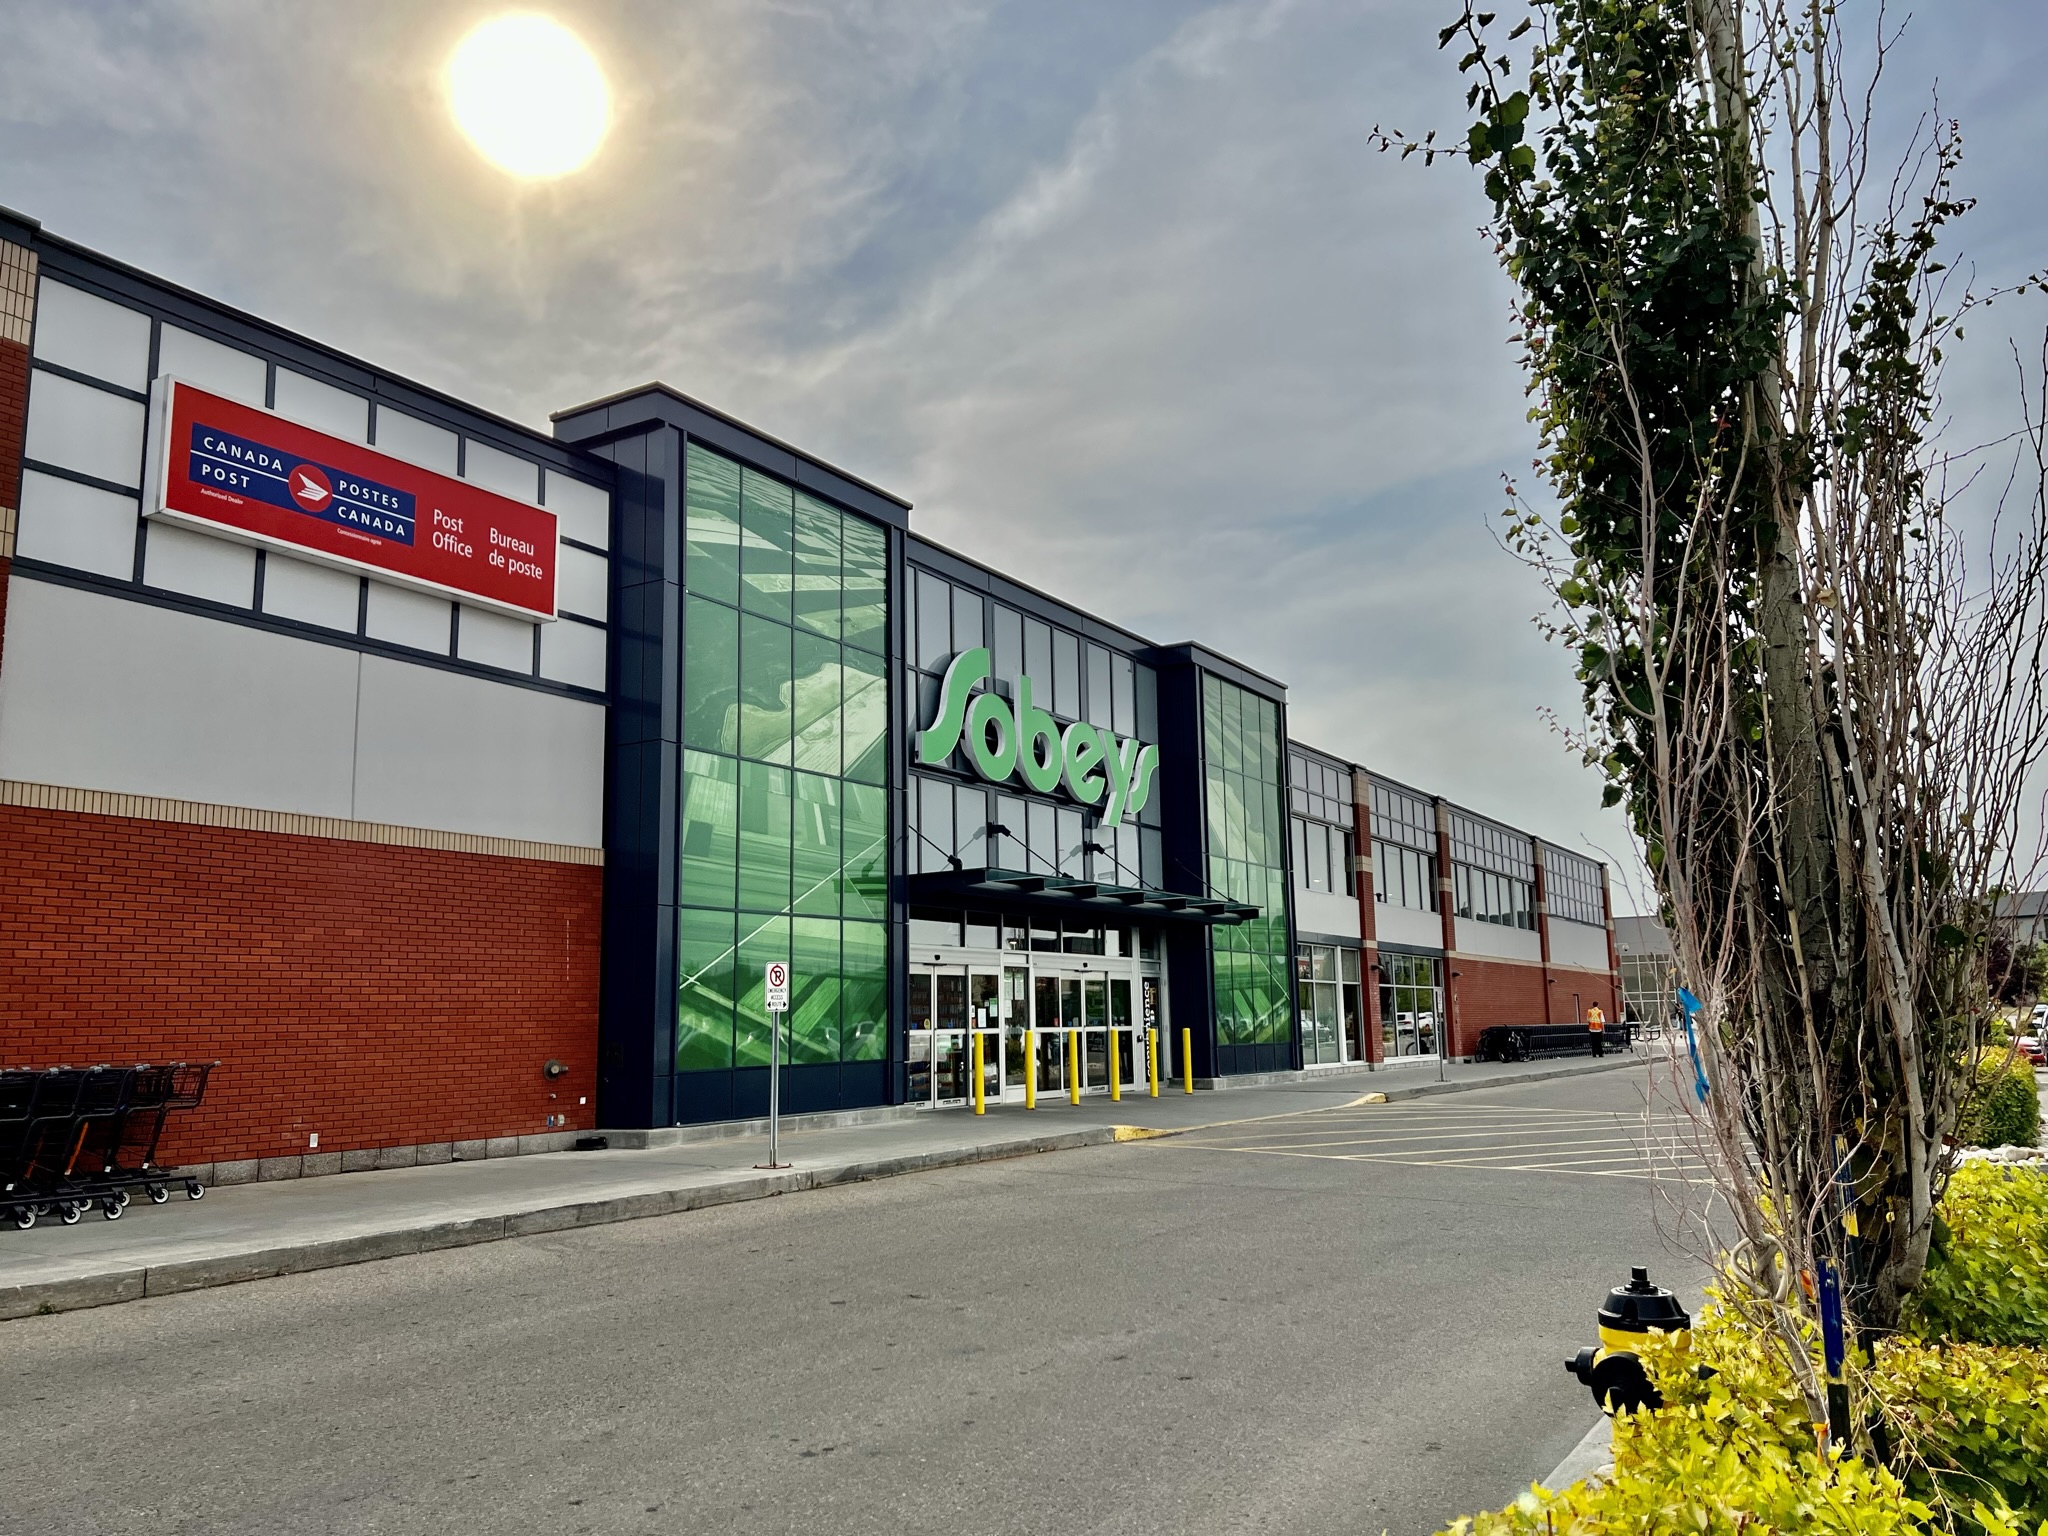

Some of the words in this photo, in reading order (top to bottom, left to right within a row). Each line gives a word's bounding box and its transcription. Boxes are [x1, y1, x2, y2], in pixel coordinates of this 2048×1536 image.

[203, 436, 283, 472] CANADA
[202, 463, 250, 488] POST
[339, 480, 399, 509] POSTES
[338, 506, 405, 536] CANADA
[433, 508, 463, 534] Post
[432, 531, 473, 558] Office
[489, 527, 535, 557] Bureau
[488, 549, 505, 568] de
[508, 558, 543, 580] poste
[915, 647, 1159, 828] Sobeys
